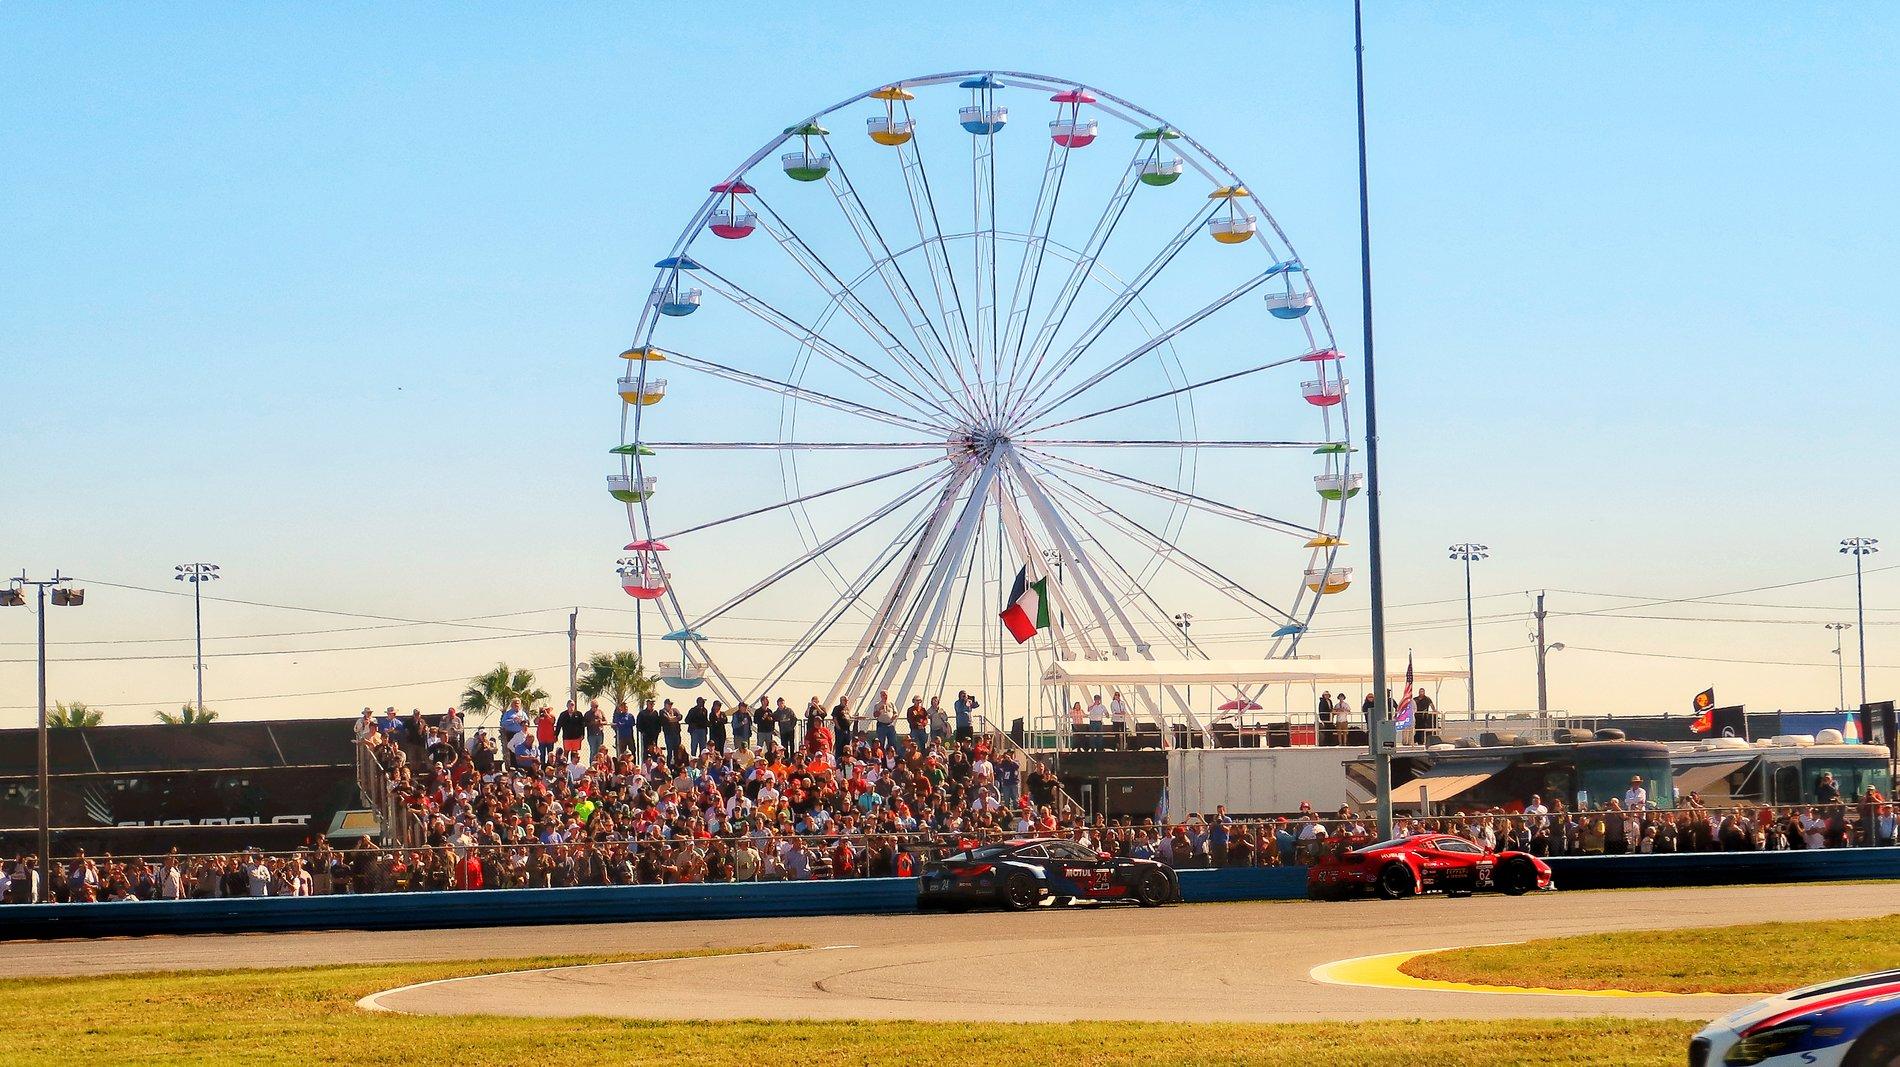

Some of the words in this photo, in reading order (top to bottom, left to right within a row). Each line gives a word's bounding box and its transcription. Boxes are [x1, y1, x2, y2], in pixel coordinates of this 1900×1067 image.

[1065, 868, 1092, 877] MOTUL
[1096, 872, 1108, 883] 24
[1479, 869, 1490, 880] 62
